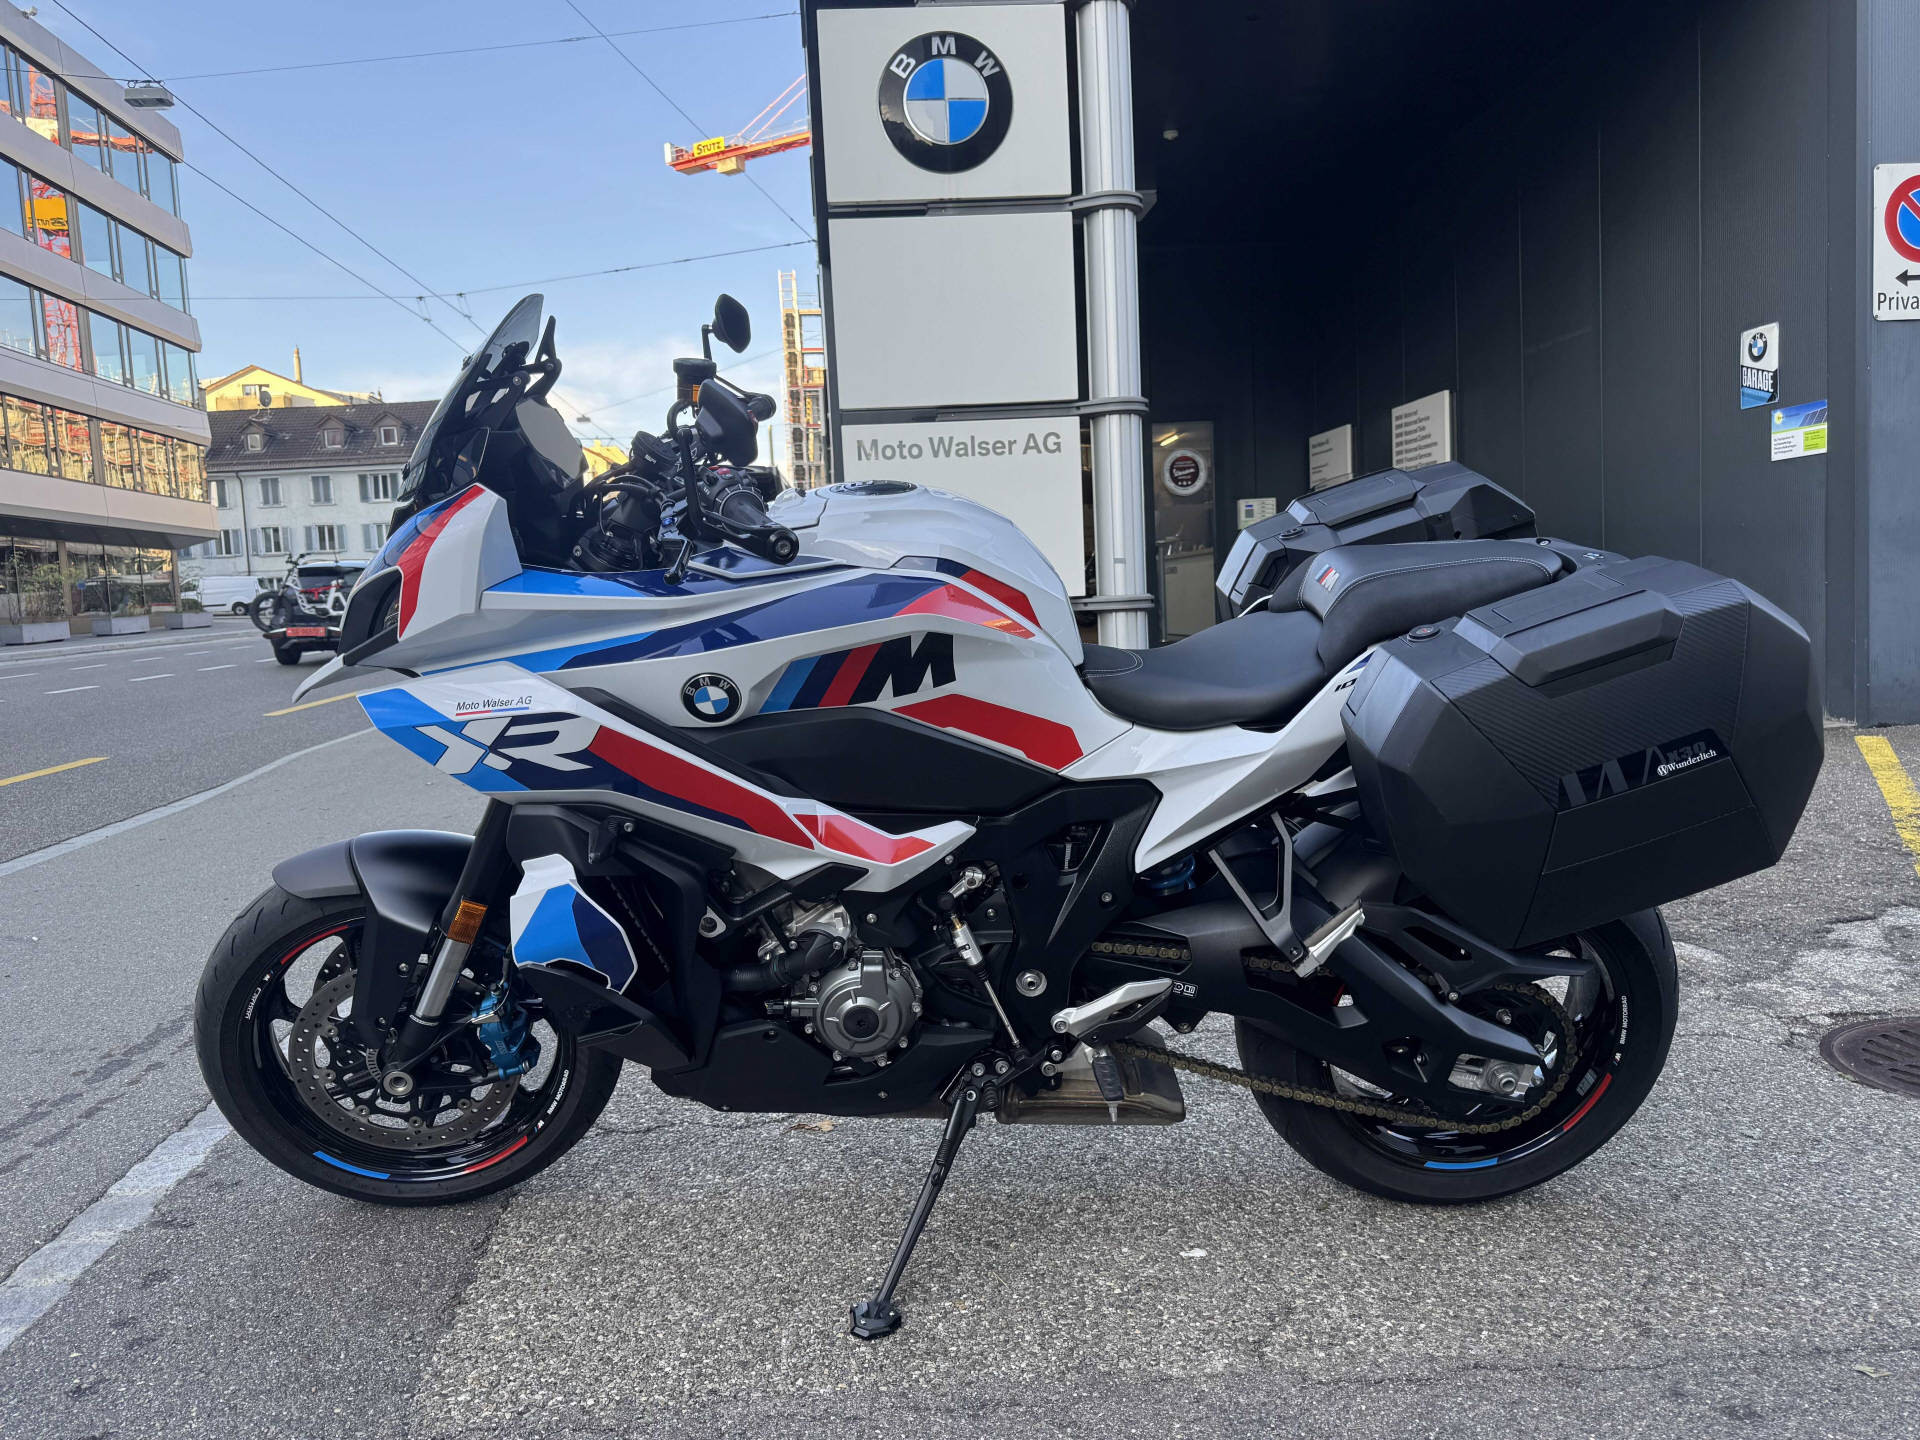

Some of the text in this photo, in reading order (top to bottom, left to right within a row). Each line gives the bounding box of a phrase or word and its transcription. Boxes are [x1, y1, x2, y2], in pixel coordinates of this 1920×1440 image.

[890, 36, 1000, 79] BMW
[1742, 367, 1774, 392] GARAGE
[857, 431, 1062, 461] Moto Walser AG
[848, 631, 957, 705] M
[456, 695, 532, 711] Moto Walser AG
[412, 716, 601, 775] XR
[1668, 749, 1717, 772] Wunderlich
[546, 1100, 558, 1115] BMW
[555, 1069, 570, 1101] MOTORRAD
